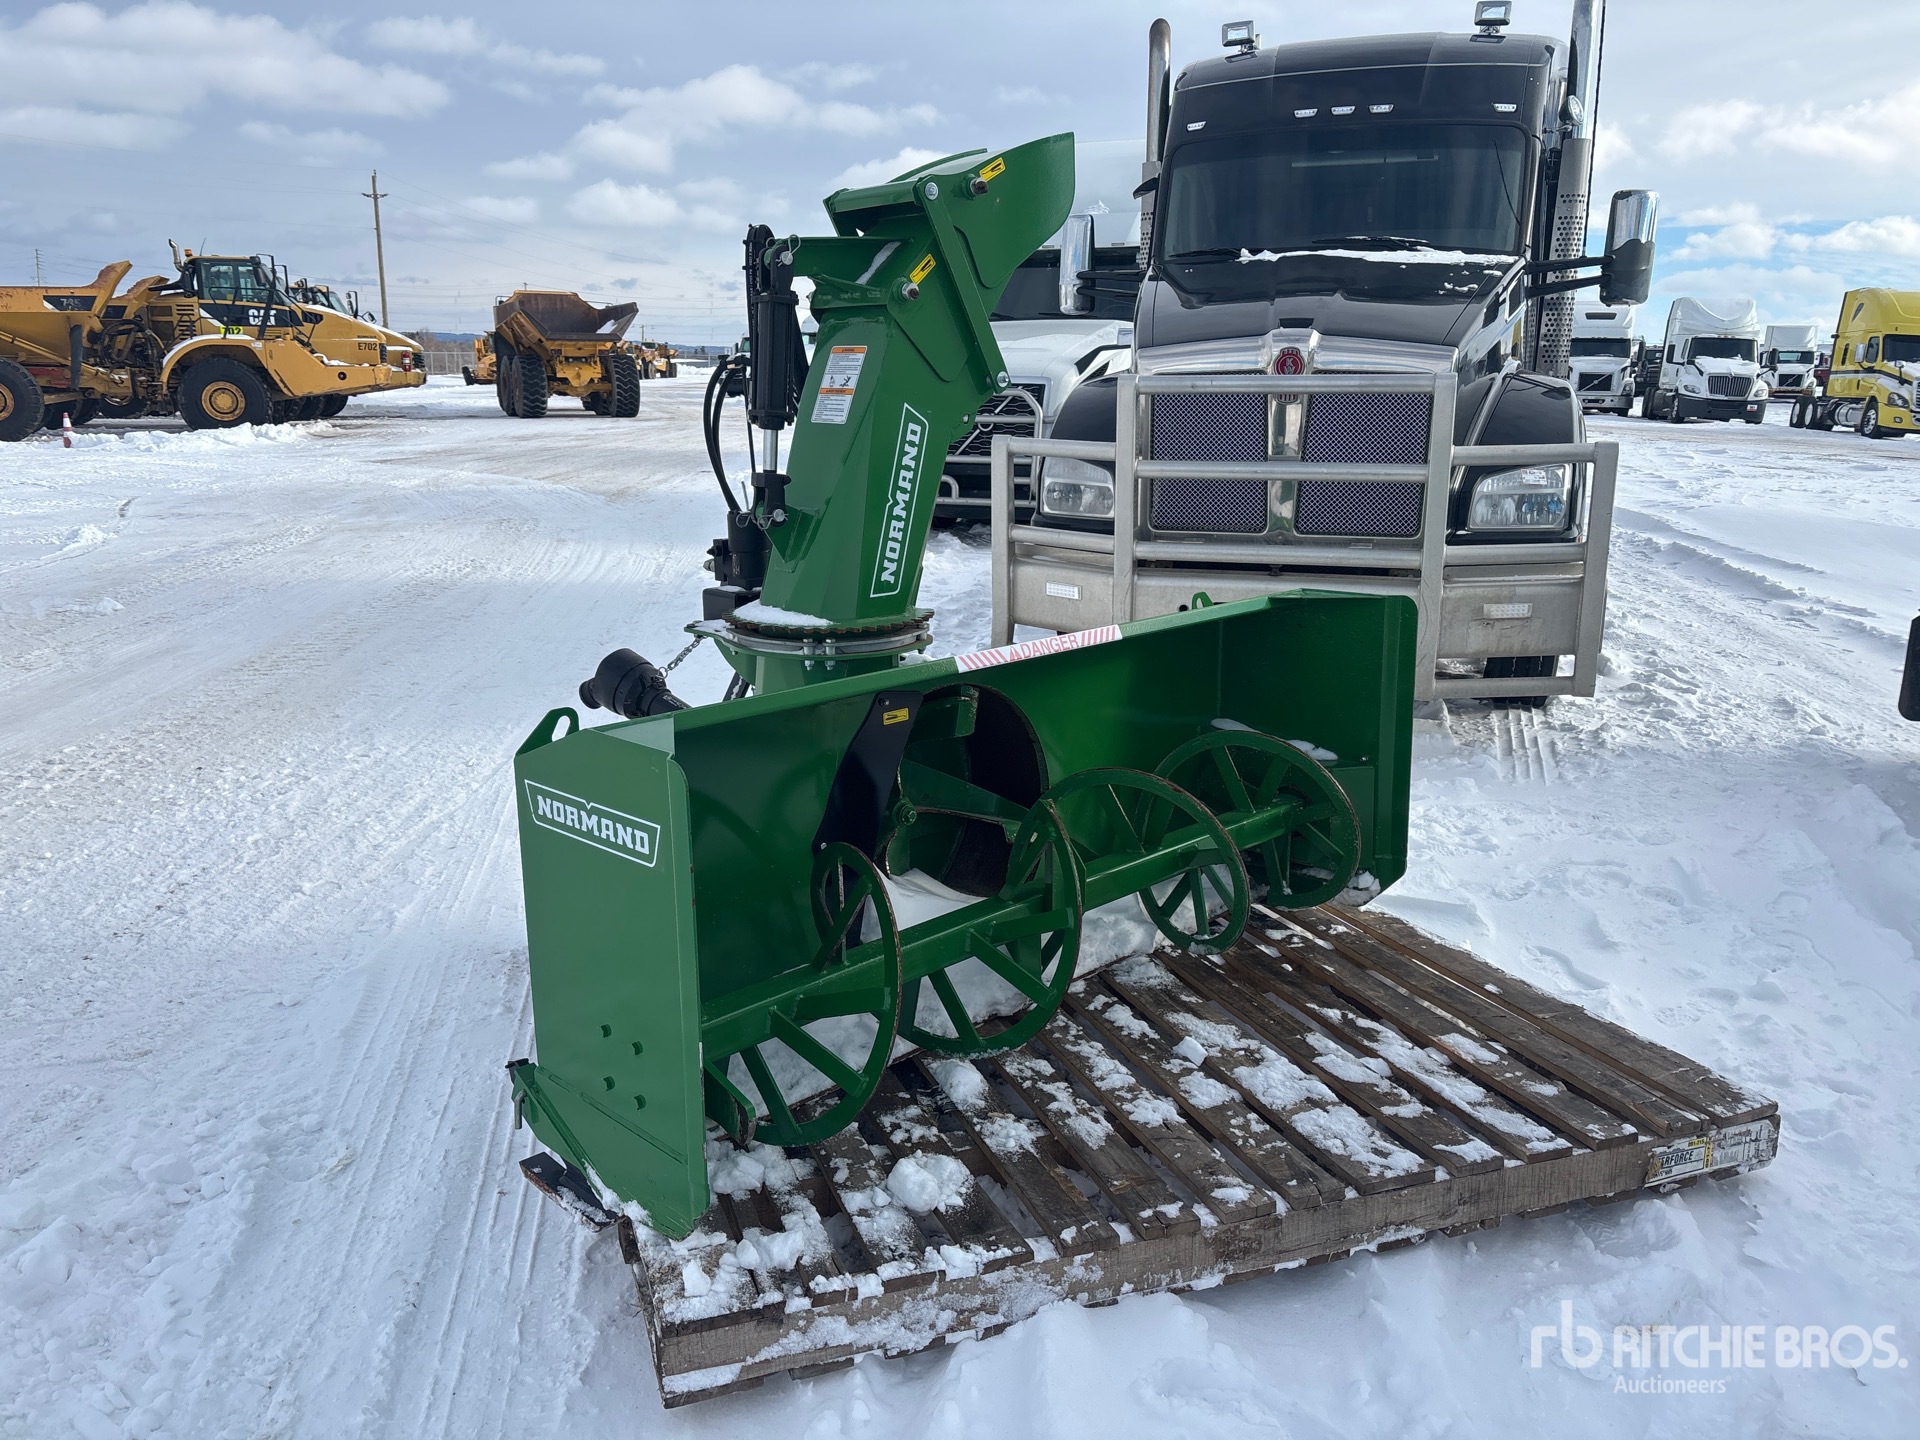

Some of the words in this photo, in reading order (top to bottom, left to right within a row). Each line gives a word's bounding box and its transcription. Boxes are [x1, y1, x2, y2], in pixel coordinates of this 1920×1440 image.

[357, 342, 378, 351] E702
[880, 422, 922, 584] NORMAND
[1020, 634, 1079, 659] DANGER
[537, 794, 650, 855] NORMAND
[1659, 1150, 1694, 1166] ERFORCE
